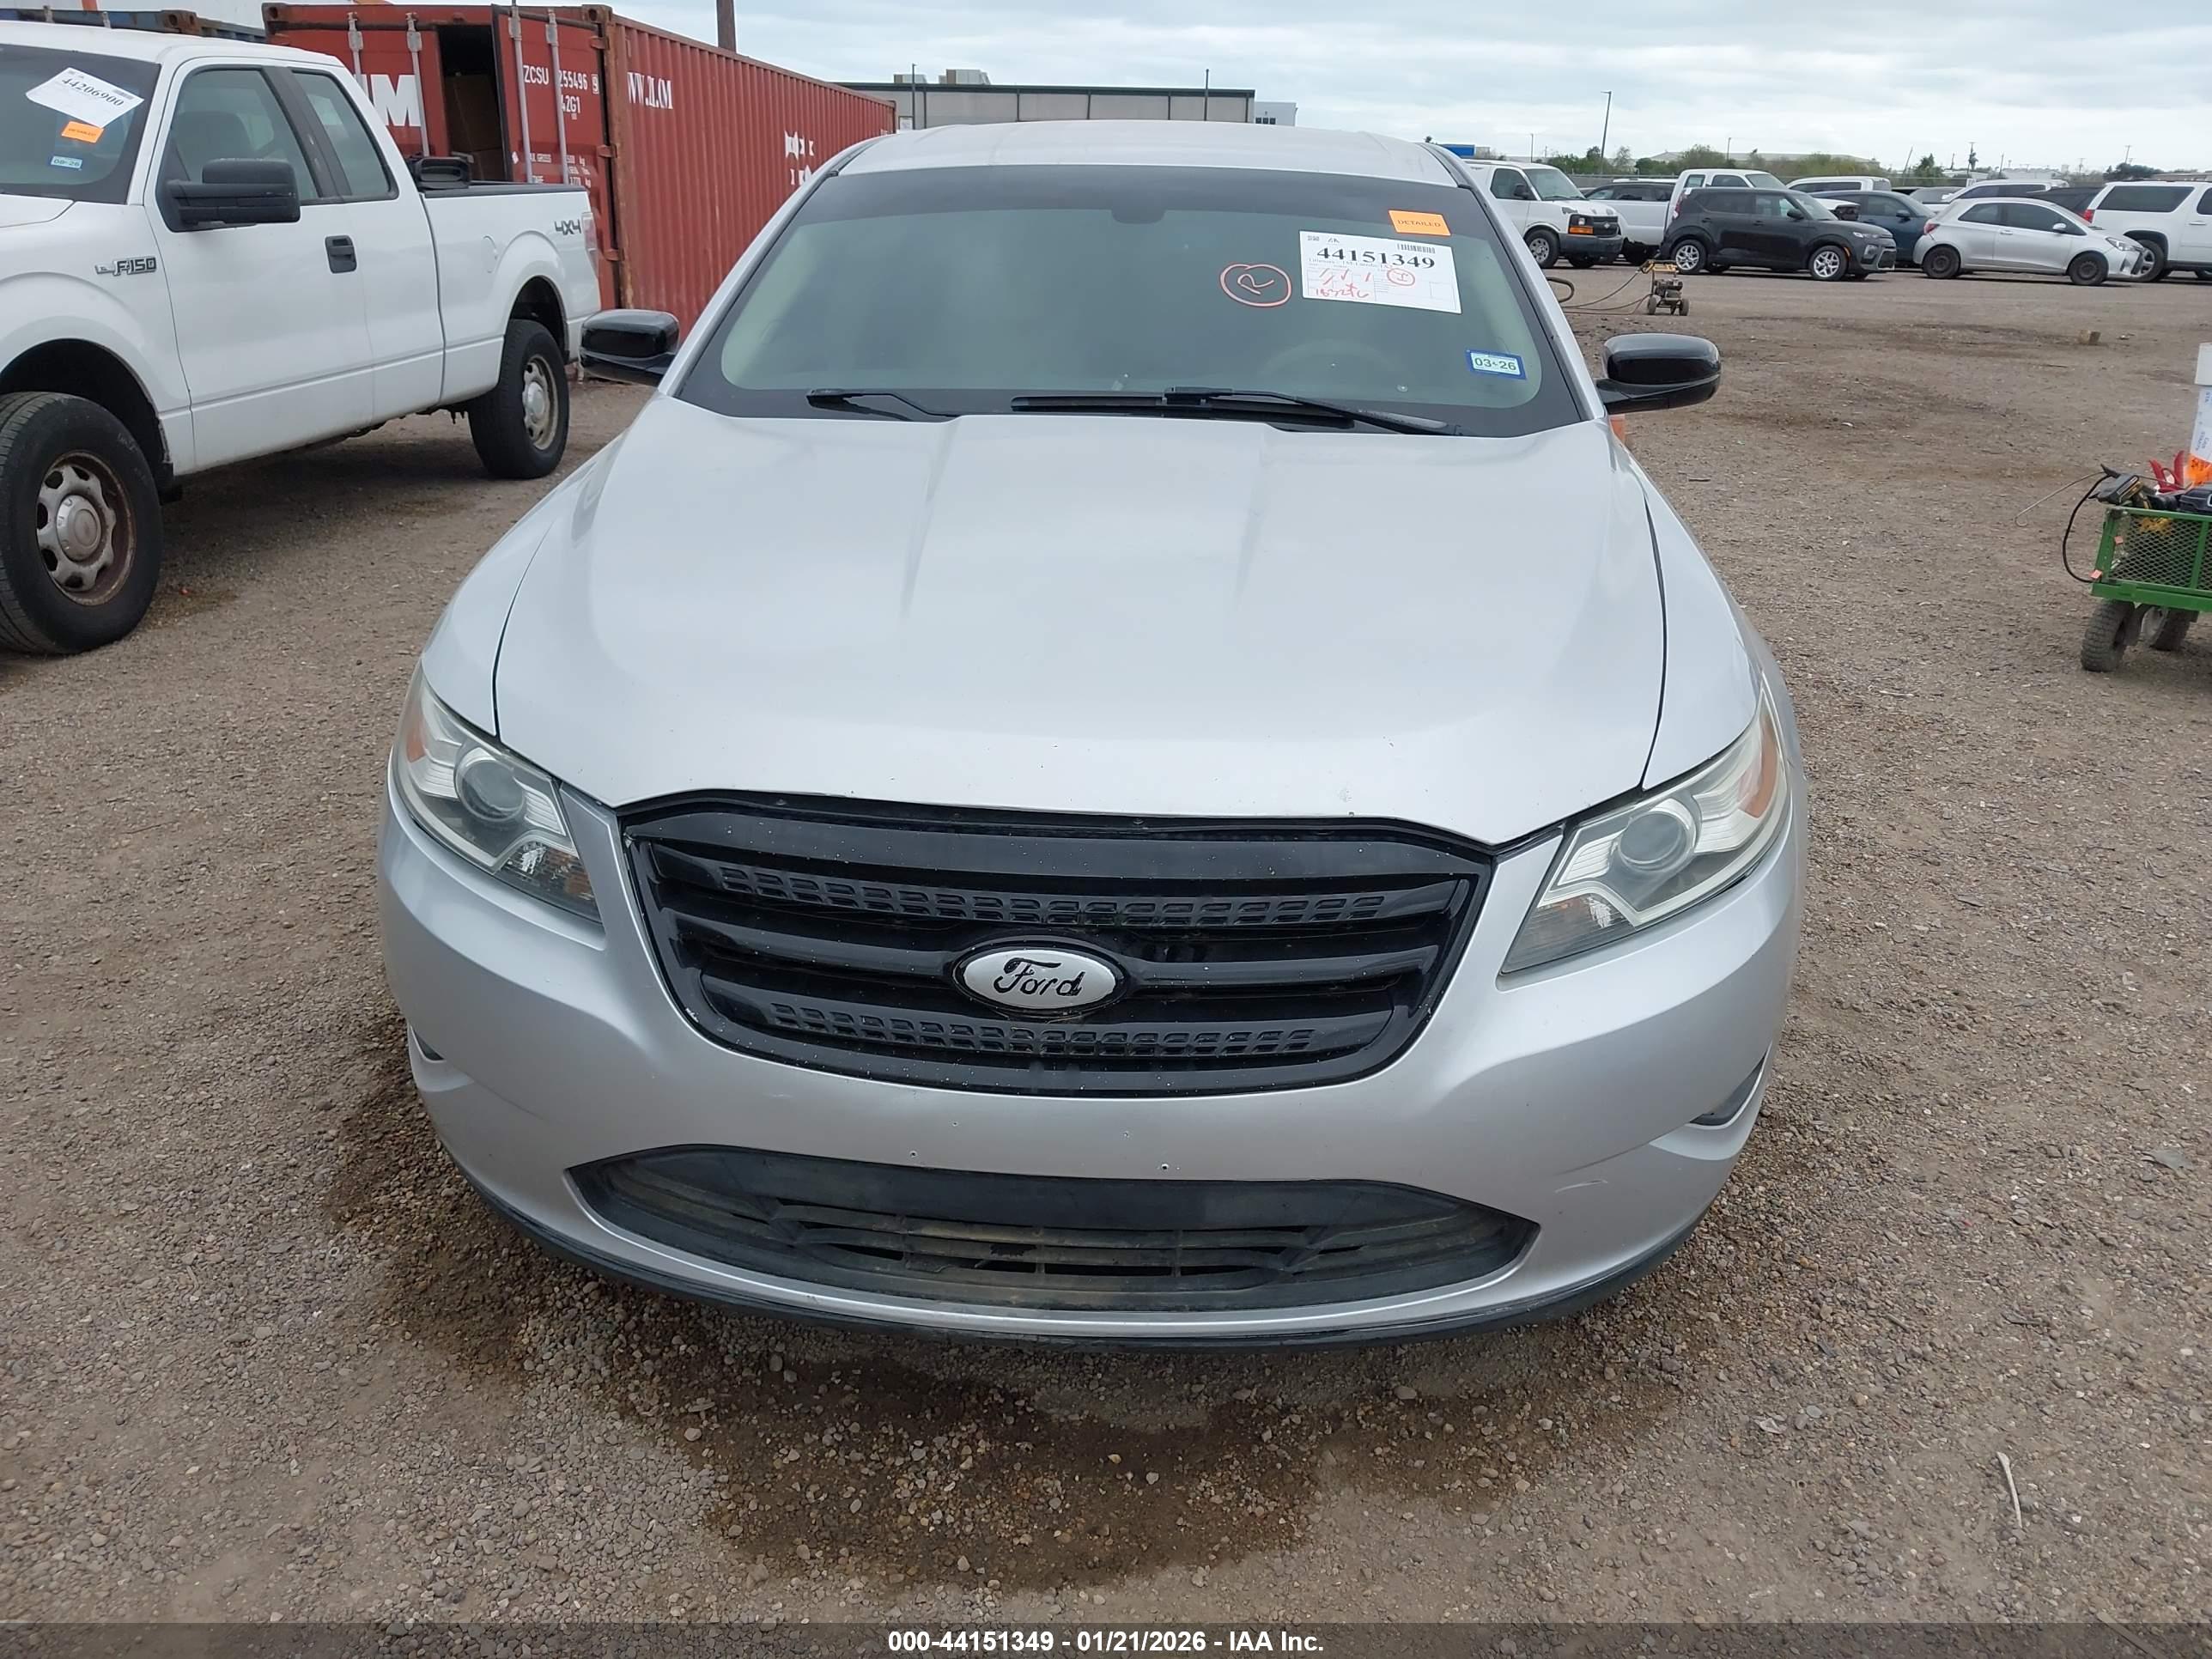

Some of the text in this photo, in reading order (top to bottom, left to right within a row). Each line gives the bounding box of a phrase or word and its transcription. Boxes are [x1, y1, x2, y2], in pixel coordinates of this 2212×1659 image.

[523, 65, 550, 85] ZCSU
[61, 78, 125, 106] 44206900
[1397, 219, 1442, 228] DETAILED
[1316, 246, 1435, 269] 44151349
[993, 957, 1086, 996] Ford
